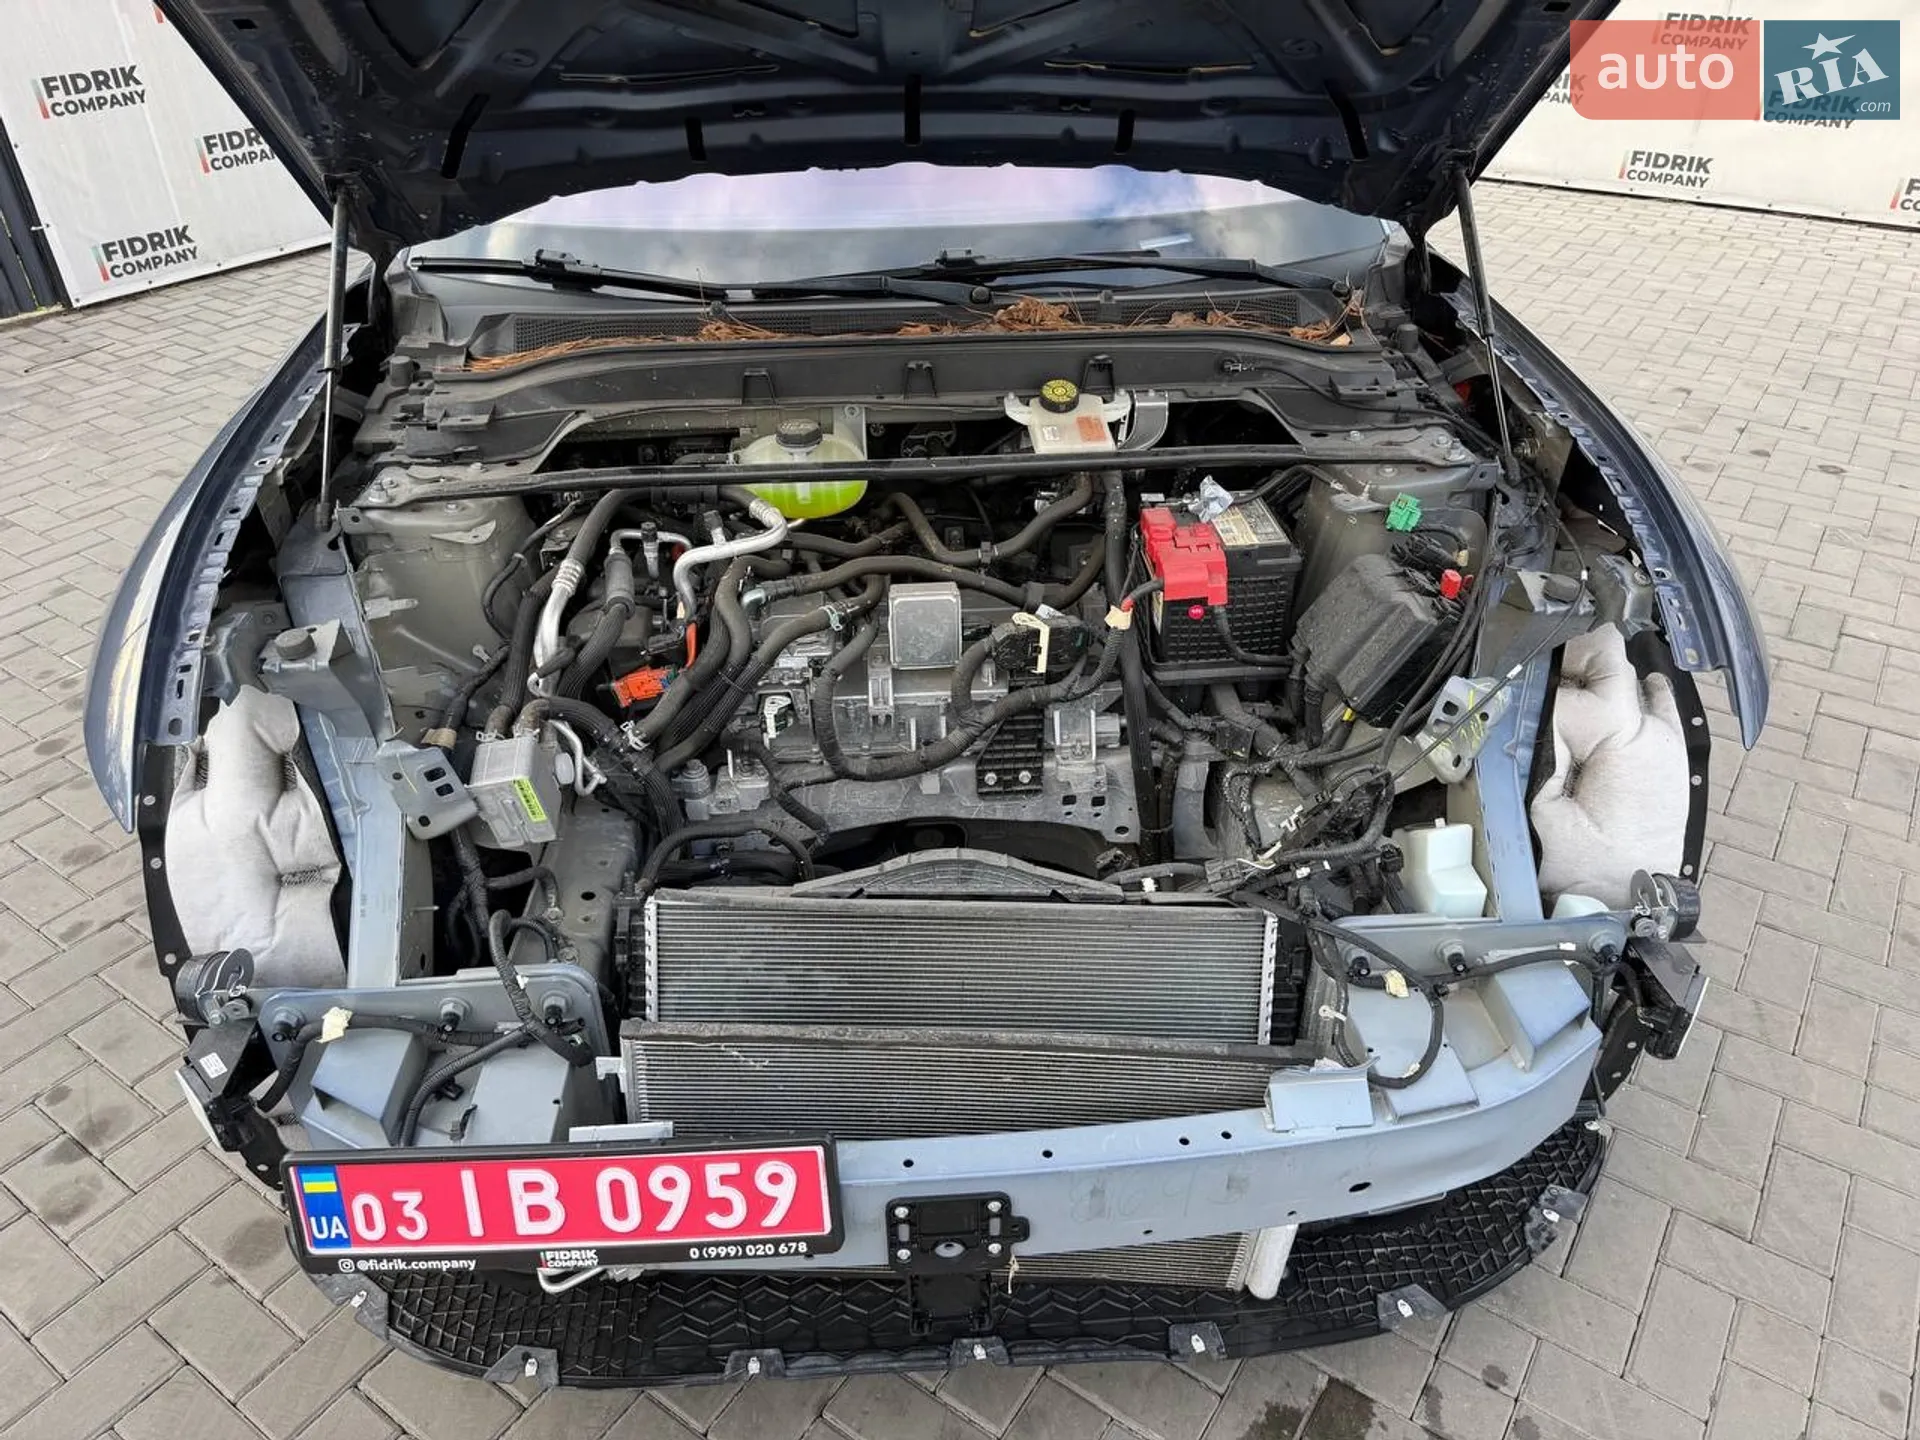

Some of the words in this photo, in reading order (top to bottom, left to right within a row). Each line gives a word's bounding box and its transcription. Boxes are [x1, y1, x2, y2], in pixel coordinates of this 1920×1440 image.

[41, 65, 143, 98] FIDRIK
[50, 89, 145, 117] COMPANY
[1764, 111, 1855, 128] COMPANY
[1630, 150, 1714, 174] FIDRIK
[1627, 169, 1709, 188] COMPANY
[101, 225, 194, 262] FIDRIK
[110, 246, 198, 278] COMPANY
[352, 1192, 428, 1241] 03
[595, 1160, 798, 1233] 0959
[310, 1216, 348, 1239] UA
[545, 1249, 598, 1260] FIDRIK
[689, 1247, 699, 1259] 0
[702, 1245, 742, 1258] (999)
[745, 1243, 775, 1256] 020
[778, 1241, 808, 1254] 678
[547, 1258, 599, 1268] COMPANY
